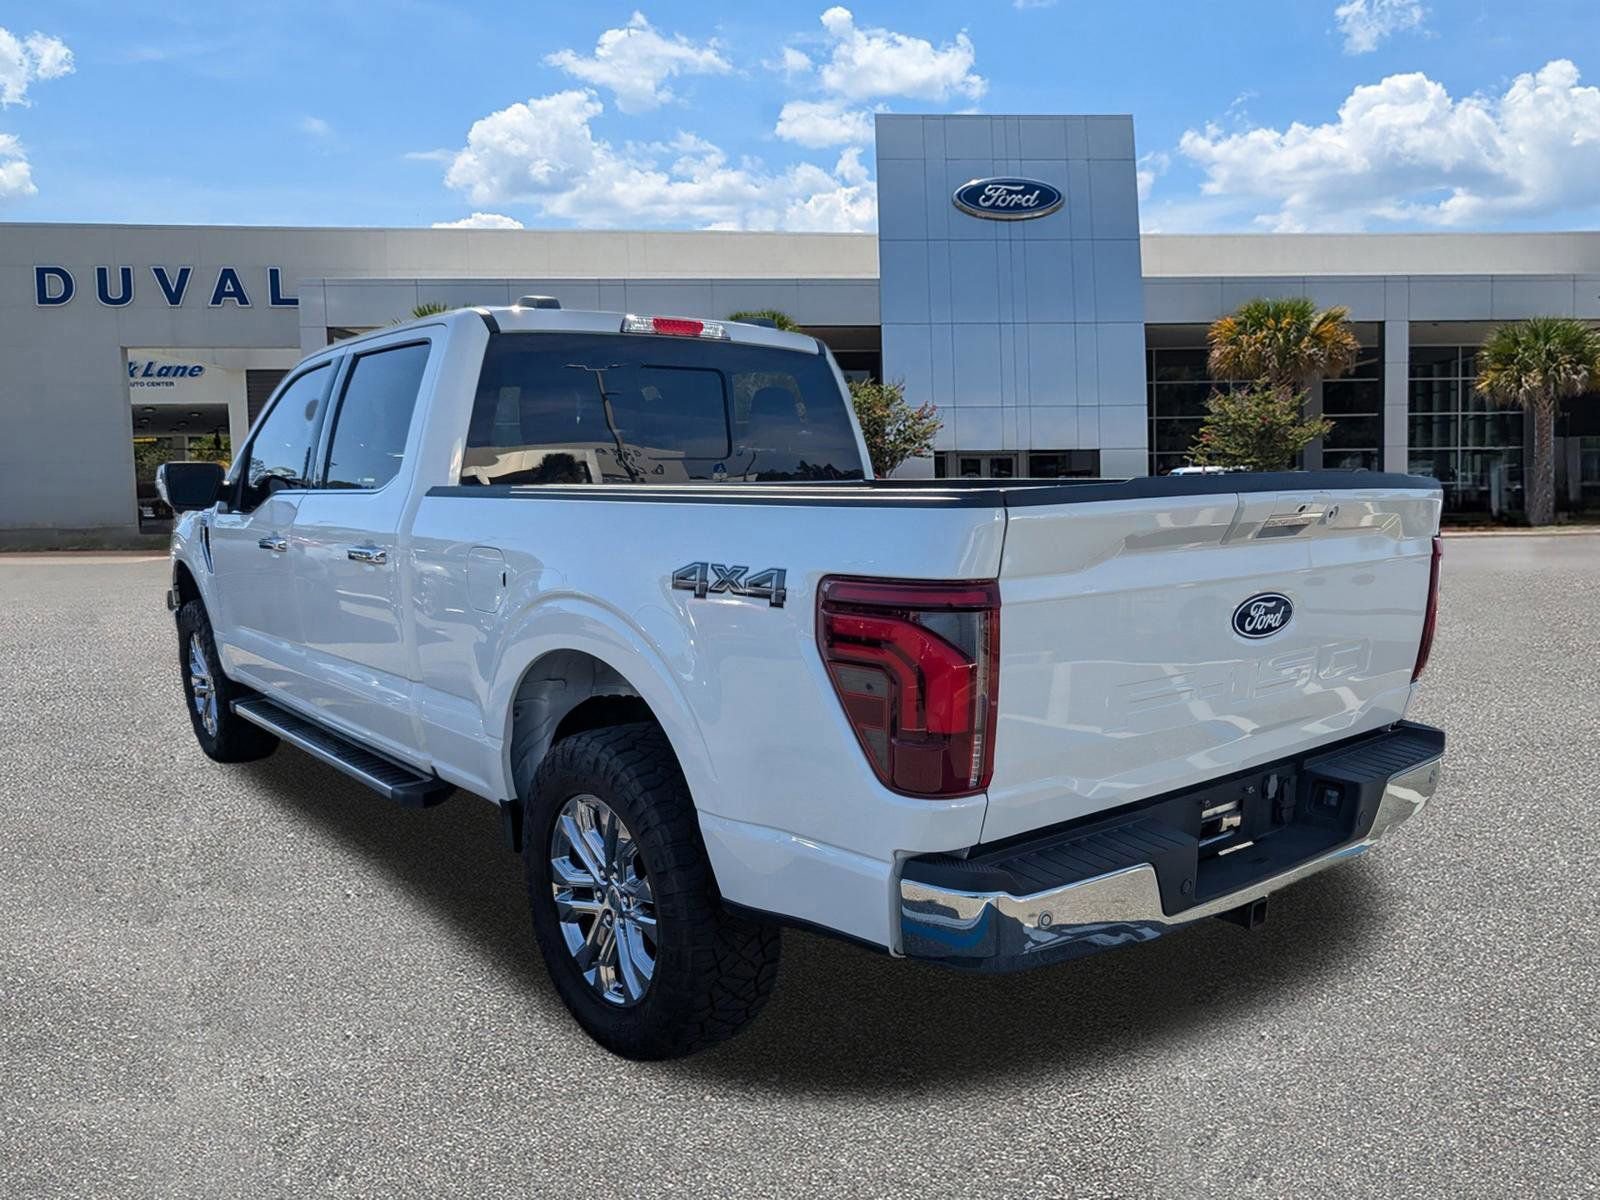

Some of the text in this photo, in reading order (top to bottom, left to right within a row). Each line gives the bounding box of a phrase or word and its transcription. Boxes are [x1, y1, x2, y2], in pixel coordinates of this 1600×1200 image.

[979, 185, 1040, 207] Ford
[34, 265, 299, 308] DUVAL
[141, 361, 205, 378] Lane
[1244, 600, 1285, 632] Ford
